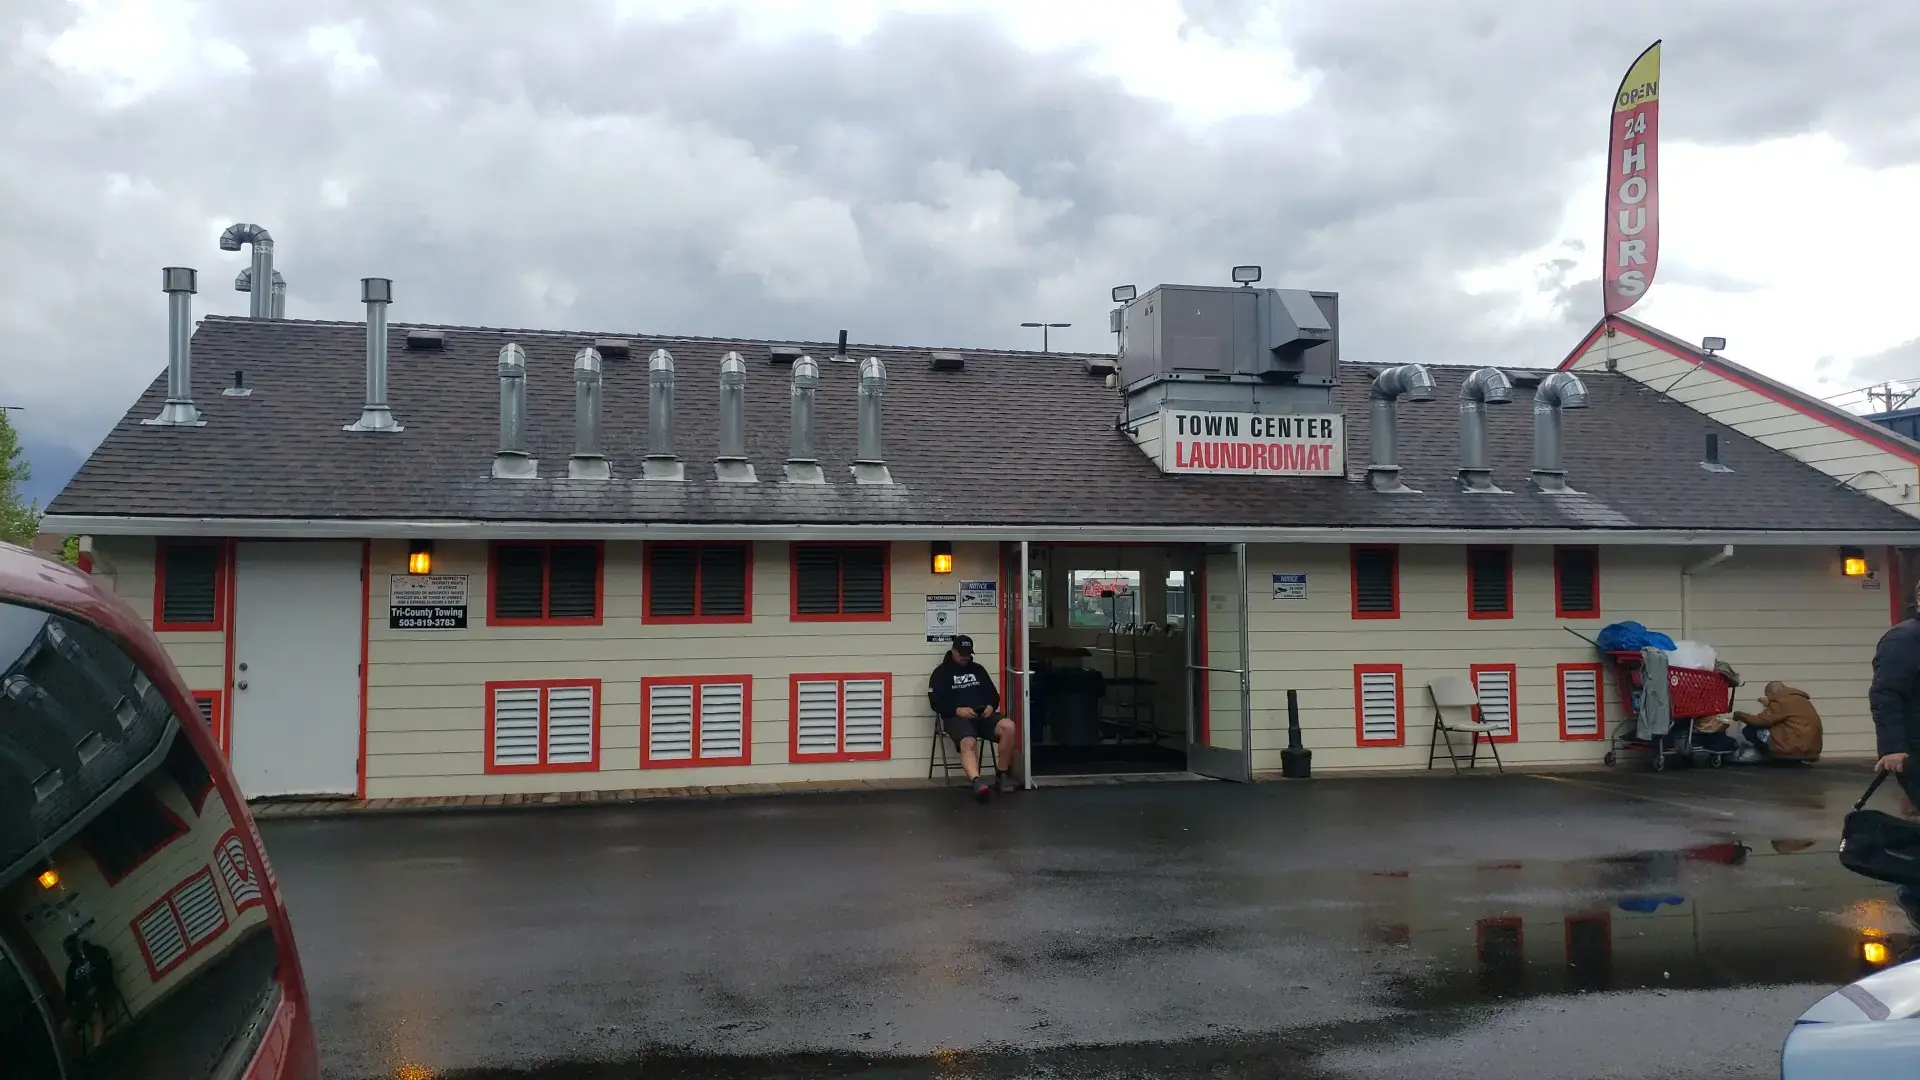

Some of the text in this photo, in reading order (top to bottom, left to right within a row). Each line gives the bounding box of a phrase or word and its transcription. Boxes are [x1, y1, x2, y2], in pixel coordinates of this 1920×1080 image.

[1619, 82, 1657, 106] OPEN
[1618, 112, 1648, 296] 24 HOURS
[1176, 414, 1333, 438] TOWN CENTER
[1176, 441, 1333, 471] LAUNDROMAT
[392, 608, 463, 618] Tri-County Towing
